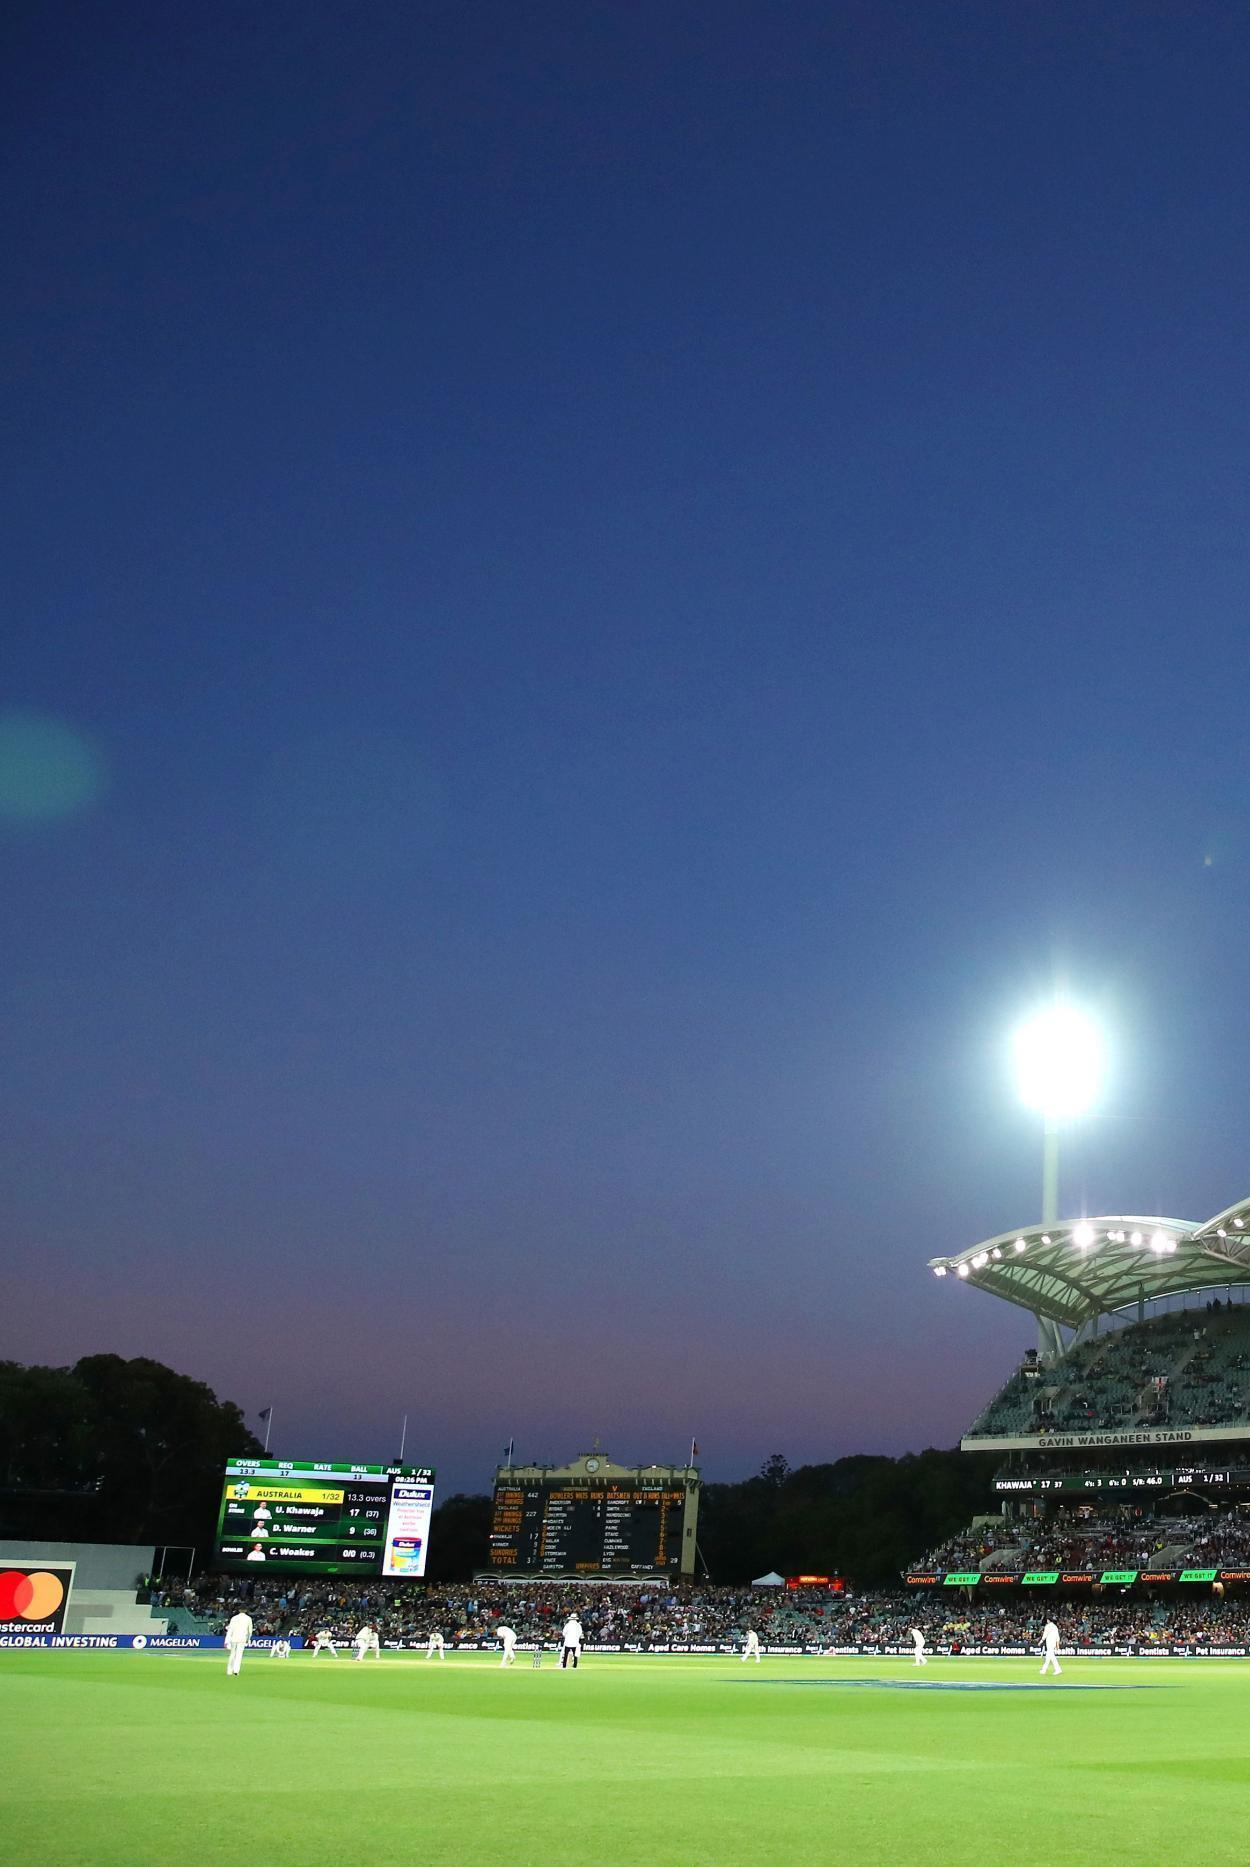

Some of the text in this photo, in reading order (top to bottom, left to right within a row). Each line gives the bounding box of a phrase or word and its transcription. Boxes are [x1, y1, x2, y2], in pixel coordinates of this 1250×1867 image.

[1038, 1432, 1192, 1447] GAVIN WANGANEEN STAND
[1041, 1480, 1051, 1489] 17
[1054, 1481, 1062, 1489] 37
[1147, 1477, 1163, 1485] 46.0
[1178, 1475, 1192, 1483] AUS
[398, 1490, 427, 1498] Dulux
[286, 1506, 324, 1516] Khawaja
[283, 1525, 316, 1533] Warner
[280, 1548, 315, 1556] Woakes
[1, 1637, 200, 1647] GLOBAL INVESTING MAGELLAN
[648, 1644, 669, 1653] Aged
[690, 1644, 715, 1652] Homes
[768, 1645, 803, 1653] Insurance
[885, 1646, 898, 1654] Pet
[960, 1646, 1026, 1655] Aged Care Homes
[1077, 1647, 1112, 1655] Insurance
[1139, 1647, 1170, 1656] Dentists
[1196, 1647, 1245, 1656] Pet Insurance
